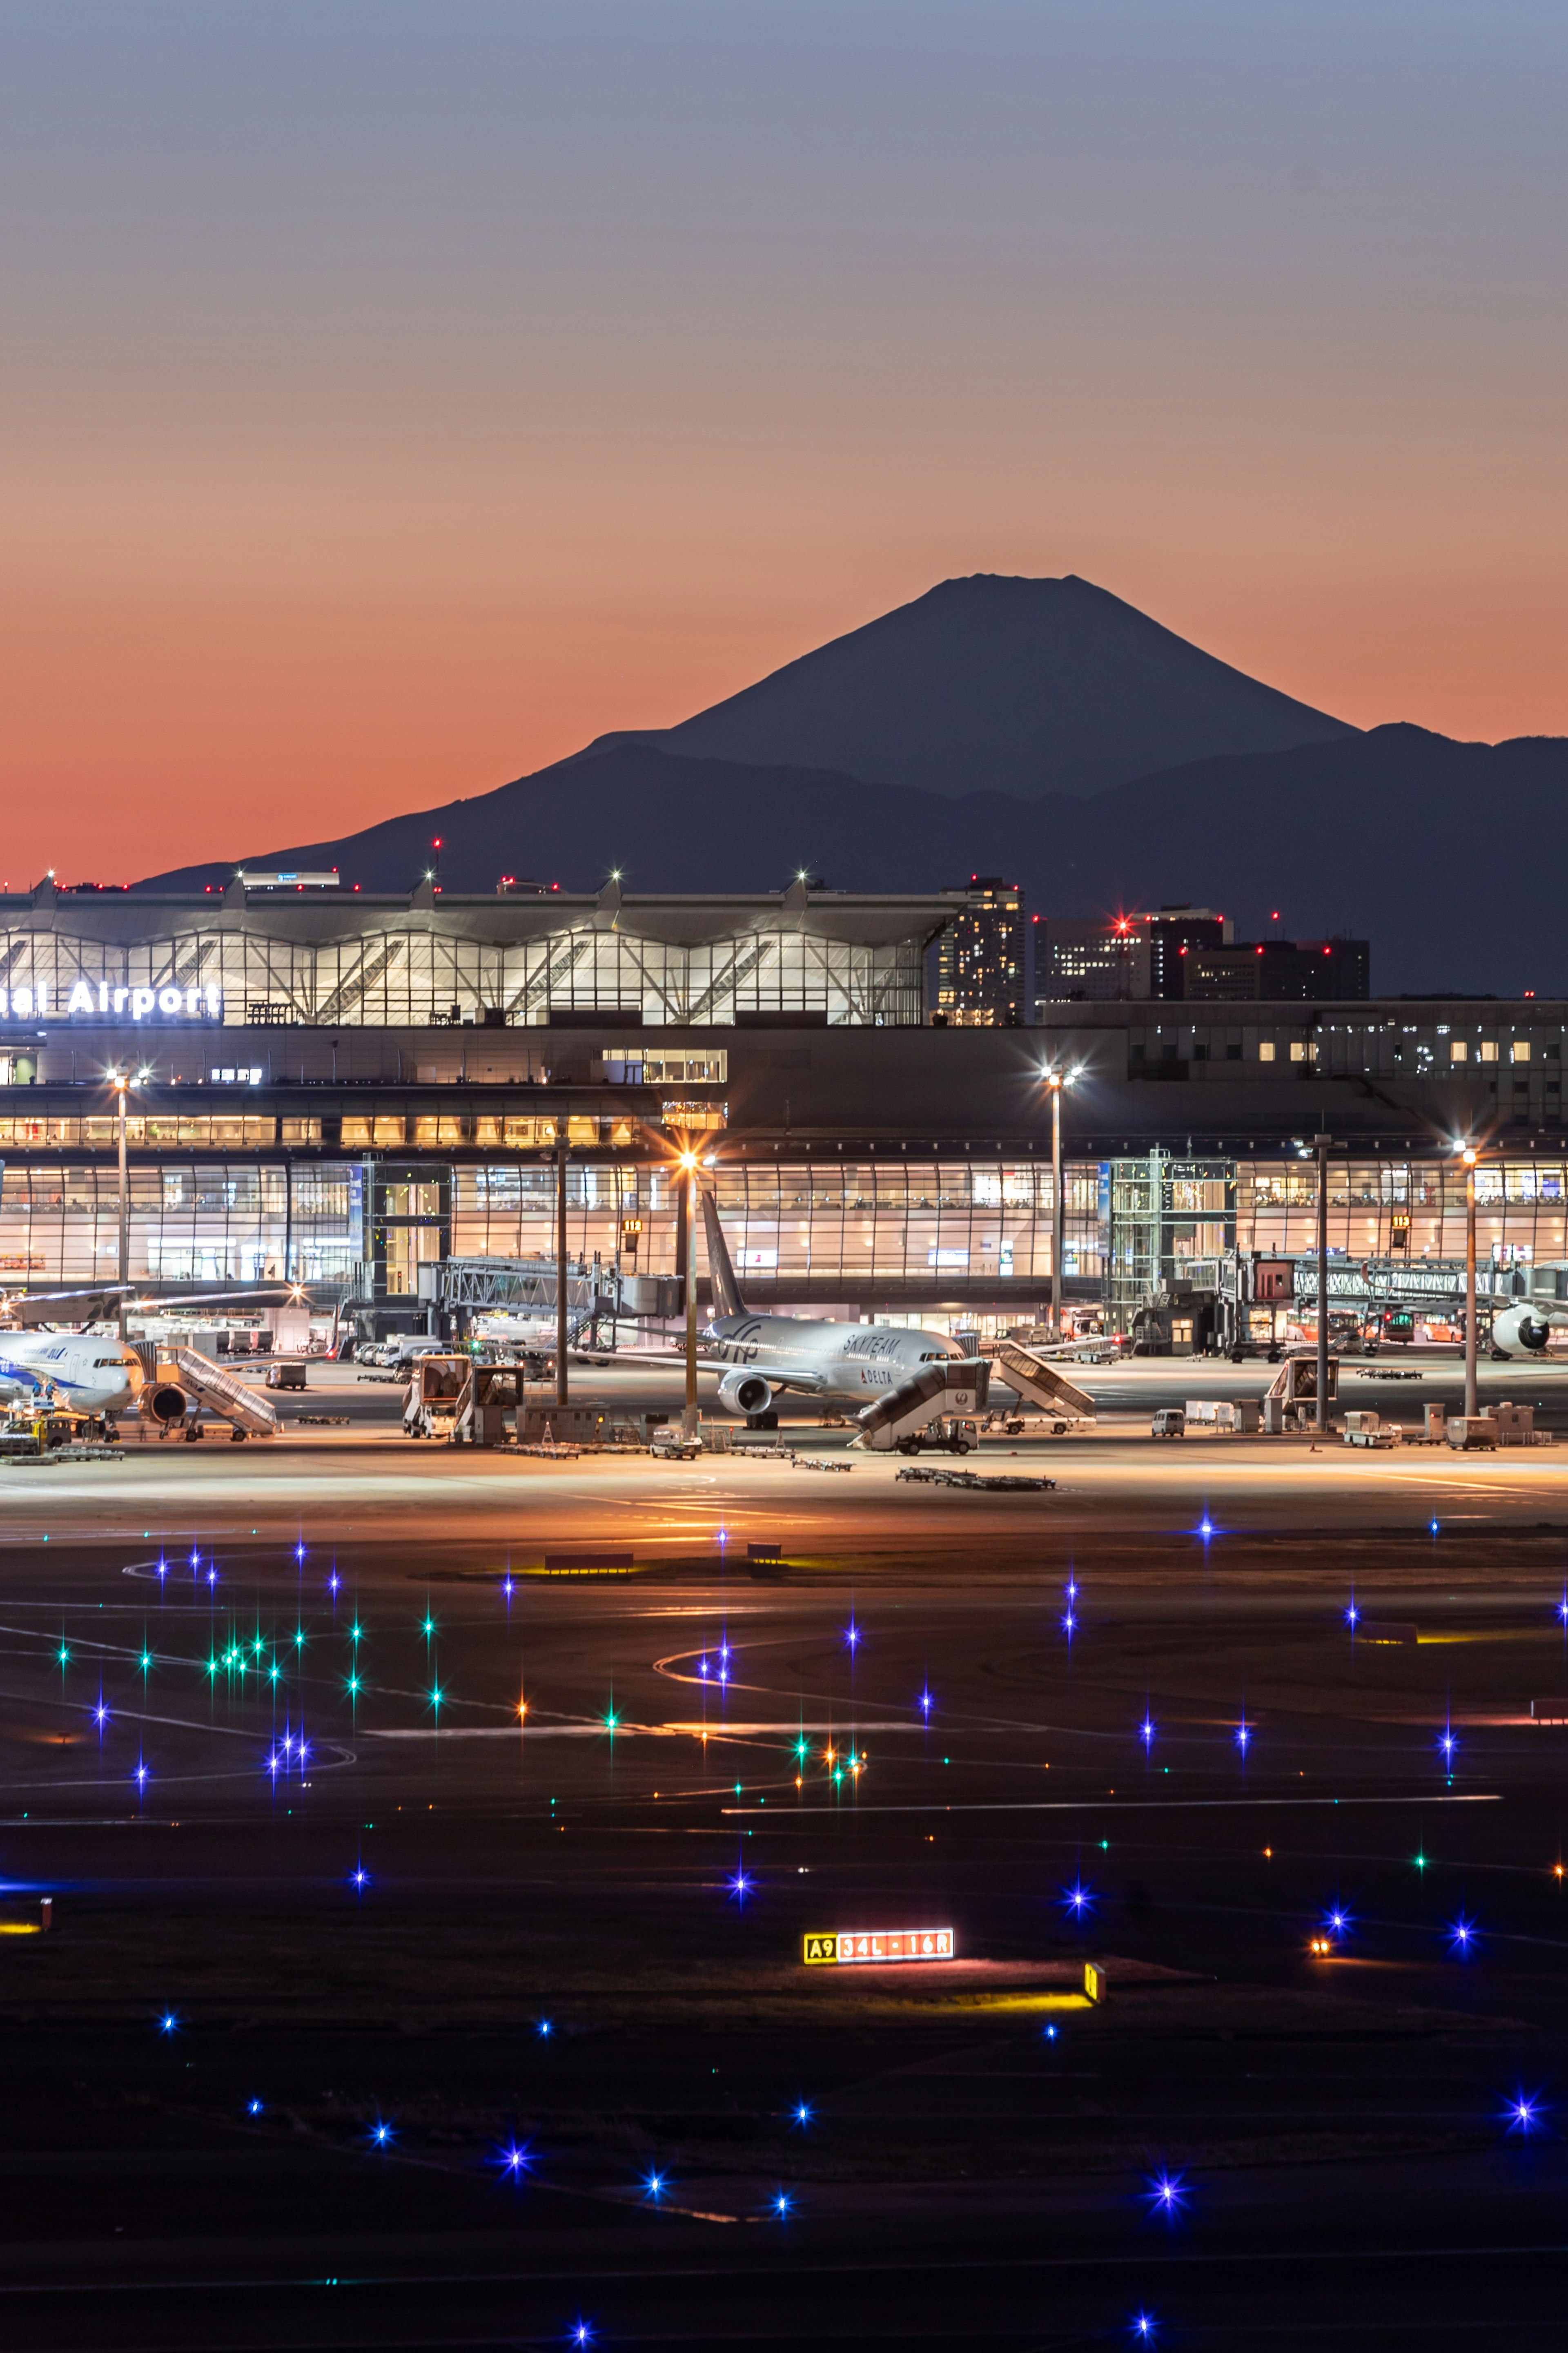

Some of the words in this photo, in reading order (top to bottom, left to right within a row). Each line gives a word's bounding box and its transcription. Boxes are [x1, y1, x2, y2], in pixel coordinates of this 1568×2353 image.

[67, 981, 219, 1020] Airport
[625, 1220, 641, 1231] 112
[1393, 1216, 1410, 1227] 113
[844, 1335, 901, 1355] SKYTEAM
[184, 1378, 198, 1389] ANA
[867, 1369, 893, 1385] DELTA
[810, 1939, 833, 1958] A9
